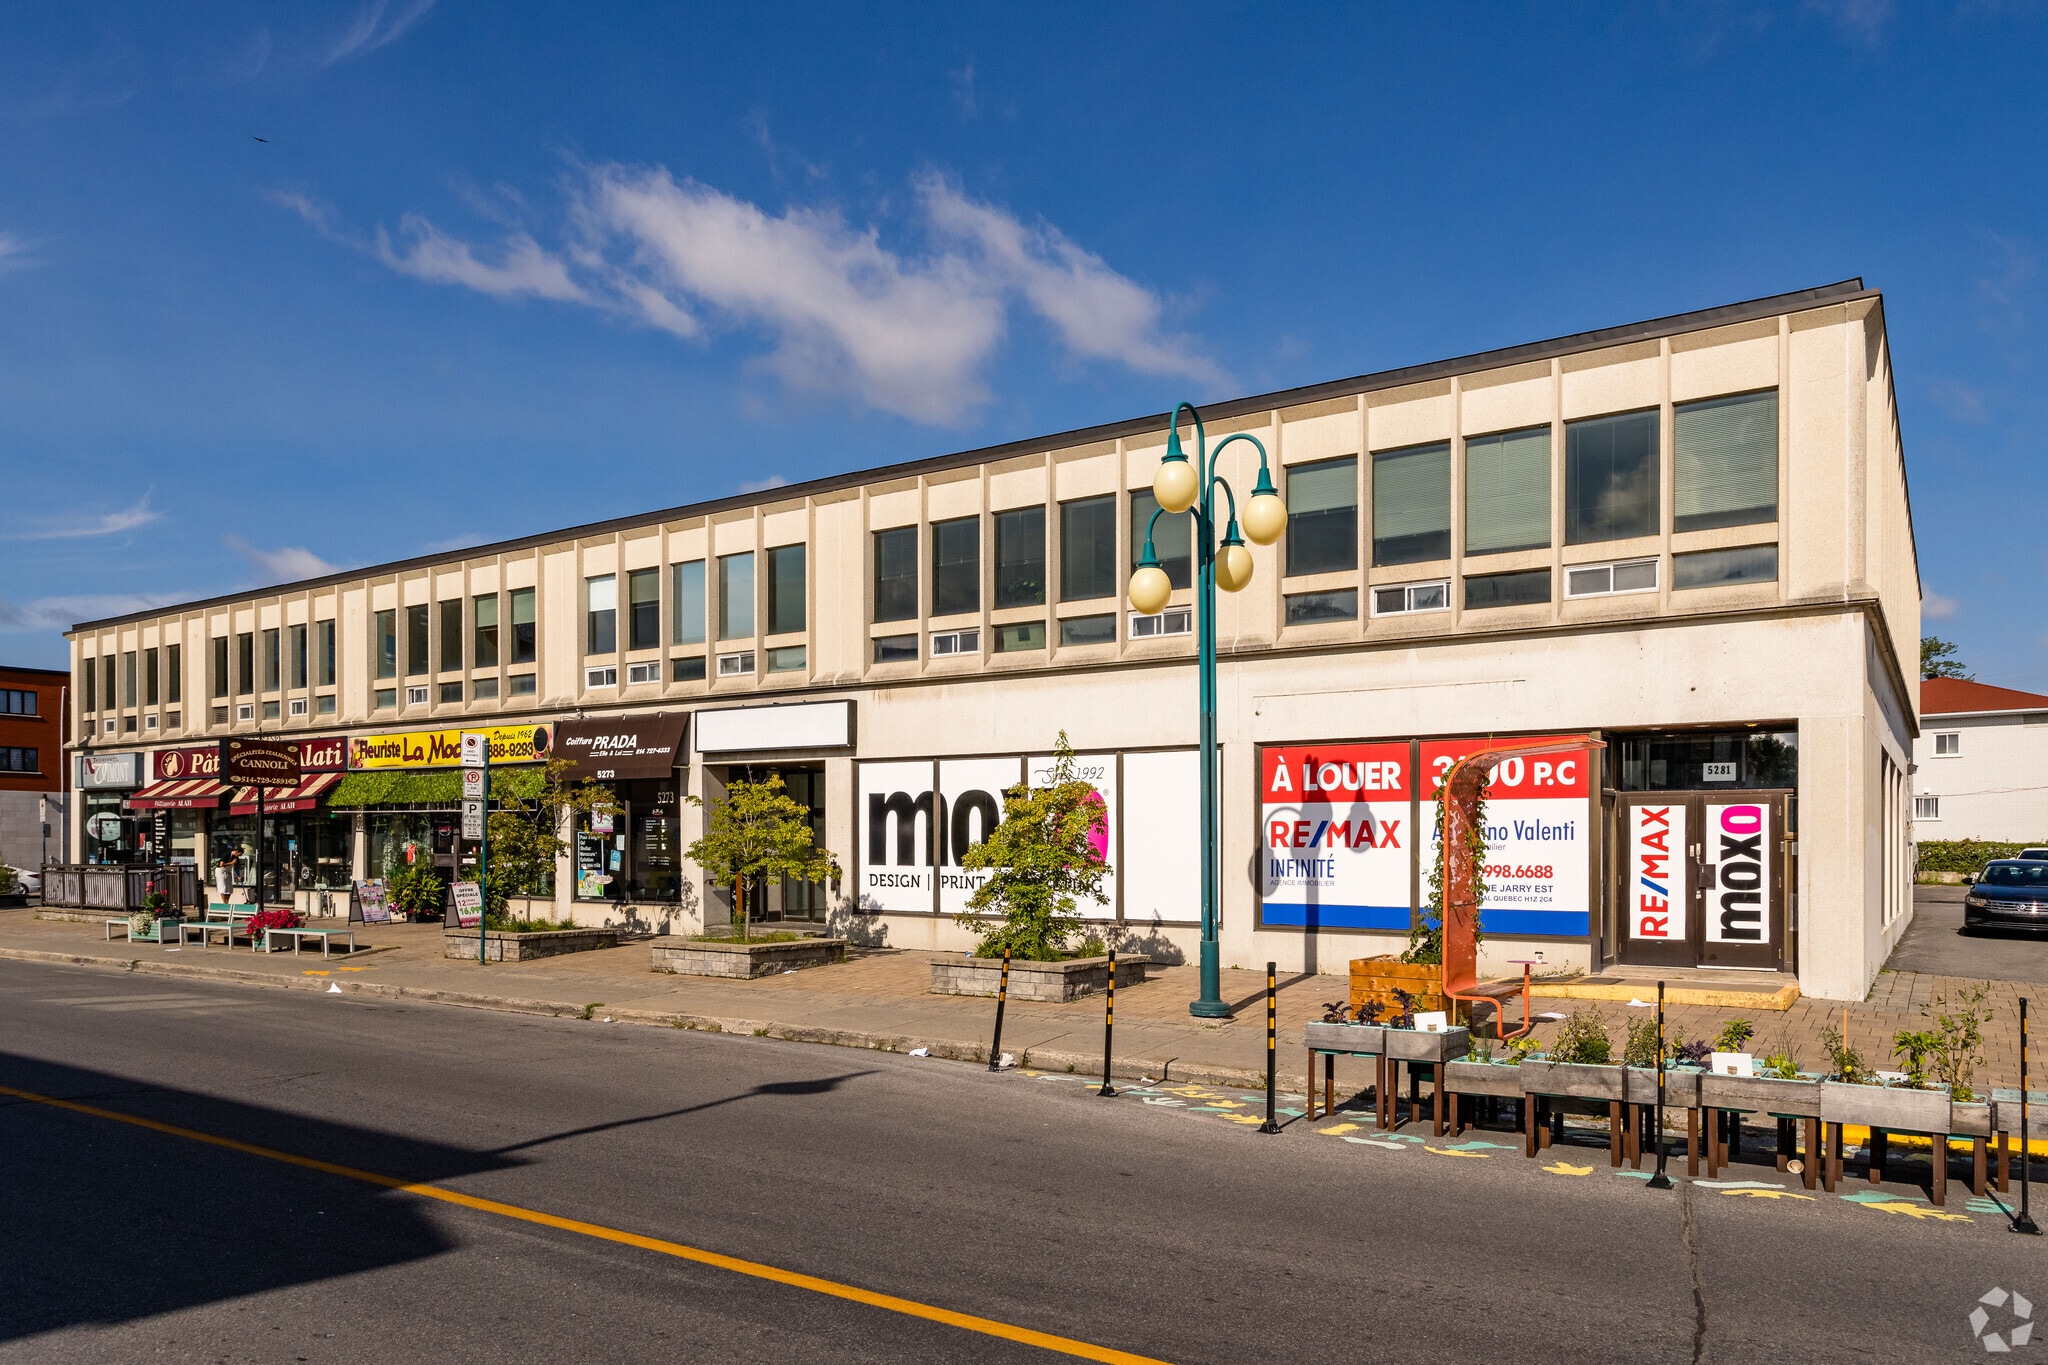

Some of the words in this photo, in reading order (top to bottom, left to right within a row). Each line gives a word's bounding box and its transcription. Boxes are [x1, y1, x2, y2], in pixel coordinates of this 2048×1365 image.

[494, 731, 515, 742] Depuis
[517, 729, 532, 739] 1962
[566, 737, 593, 746] Coiffure
[592, 734, 637, 750] PRADA
[359, 739, 400, 760] Fleuriste
[403, 736, 425, 762] La
[427, 731, 464, 765] Mod
[240, 759, 289, 770] CANNOLI
[1707, 765, 1731, 775] 5281
[597, 770, 615, 779] 5273
[1076, 766, 1105, 780] 1992
[1270, 754, 1294, 793] À
[1303, 759, 1402, 791] LOUER
[1533, 760, 1576, 786] P.C
[657, 791, 675, 804] 5273
[469, 804, 477, 814] P
[1270, 819, 1402, 849] RE/MAX
[1432, 821, 1509, 841] Aino
[1513, 818, 1575, 841] Valenti
[1270, 853, 1335, 878] INFINITÉ
[1480, 864, 1554, 879] .998.6688
[1639, 805, 1670, 937] RE/MAX
[1720, 805, 1762, 941] moxo
[869, 873, 921, 889] DESIGN
[940, 875, 986, 891] PRINT
[1500, 884, 1532, 893] JARRY
[1534, 885, 1554, 893] EST
